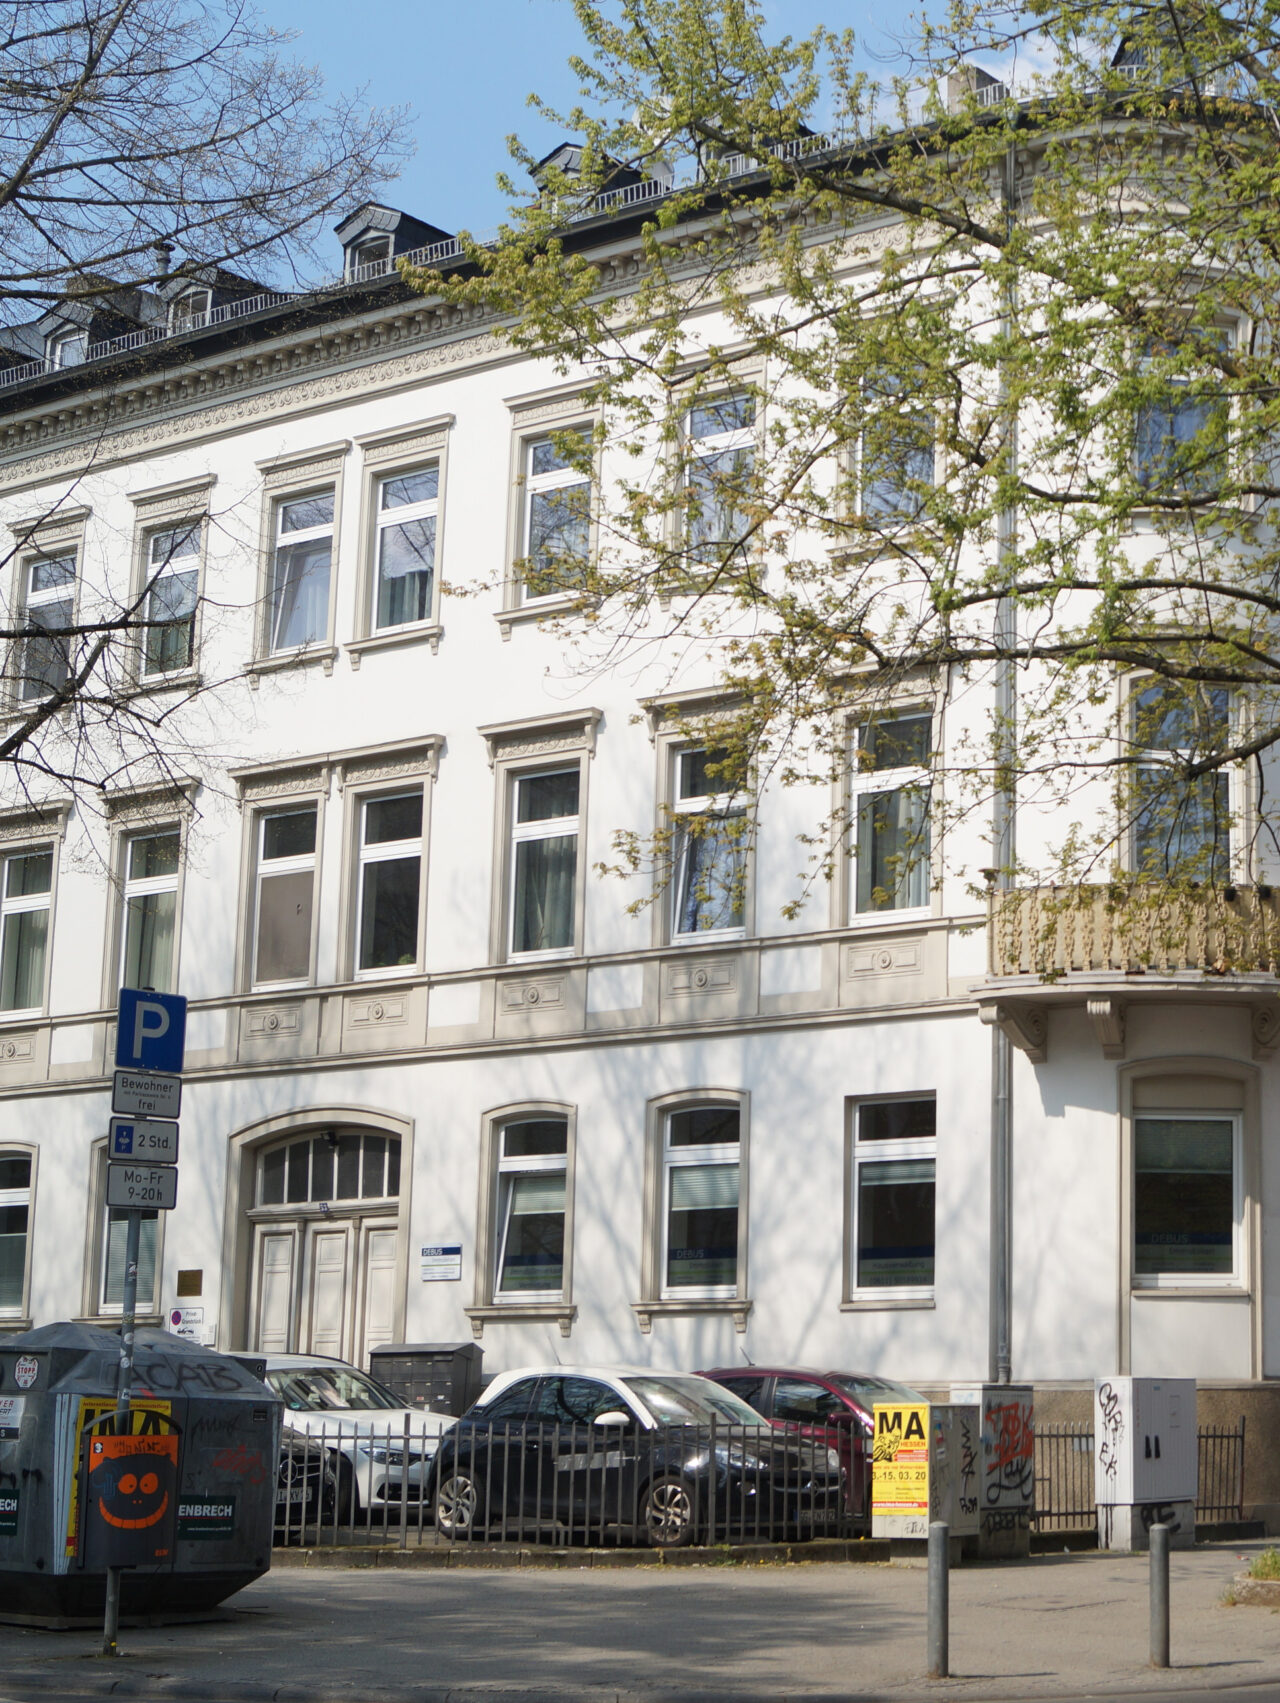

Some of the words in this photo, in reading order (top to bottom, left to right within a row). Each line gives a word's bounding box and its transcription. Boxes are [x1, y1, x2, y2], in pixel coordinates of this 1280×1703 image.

[132, 1000, 170, 1059] P
[121, 1077, 174, 1093] Bewohner
[138, 1099, 155, 1110] frei
[138, 1135, 145, 1148] 2
[149, 1135, 172, 1150] Std.
[124, 1169, 163, 1185] Mo-Fr
[423, 1248, 443, 1256] DEBUS
[676, 1249, 704, 1259] DEBUS
[915, 1471, 926, 1480] 20
